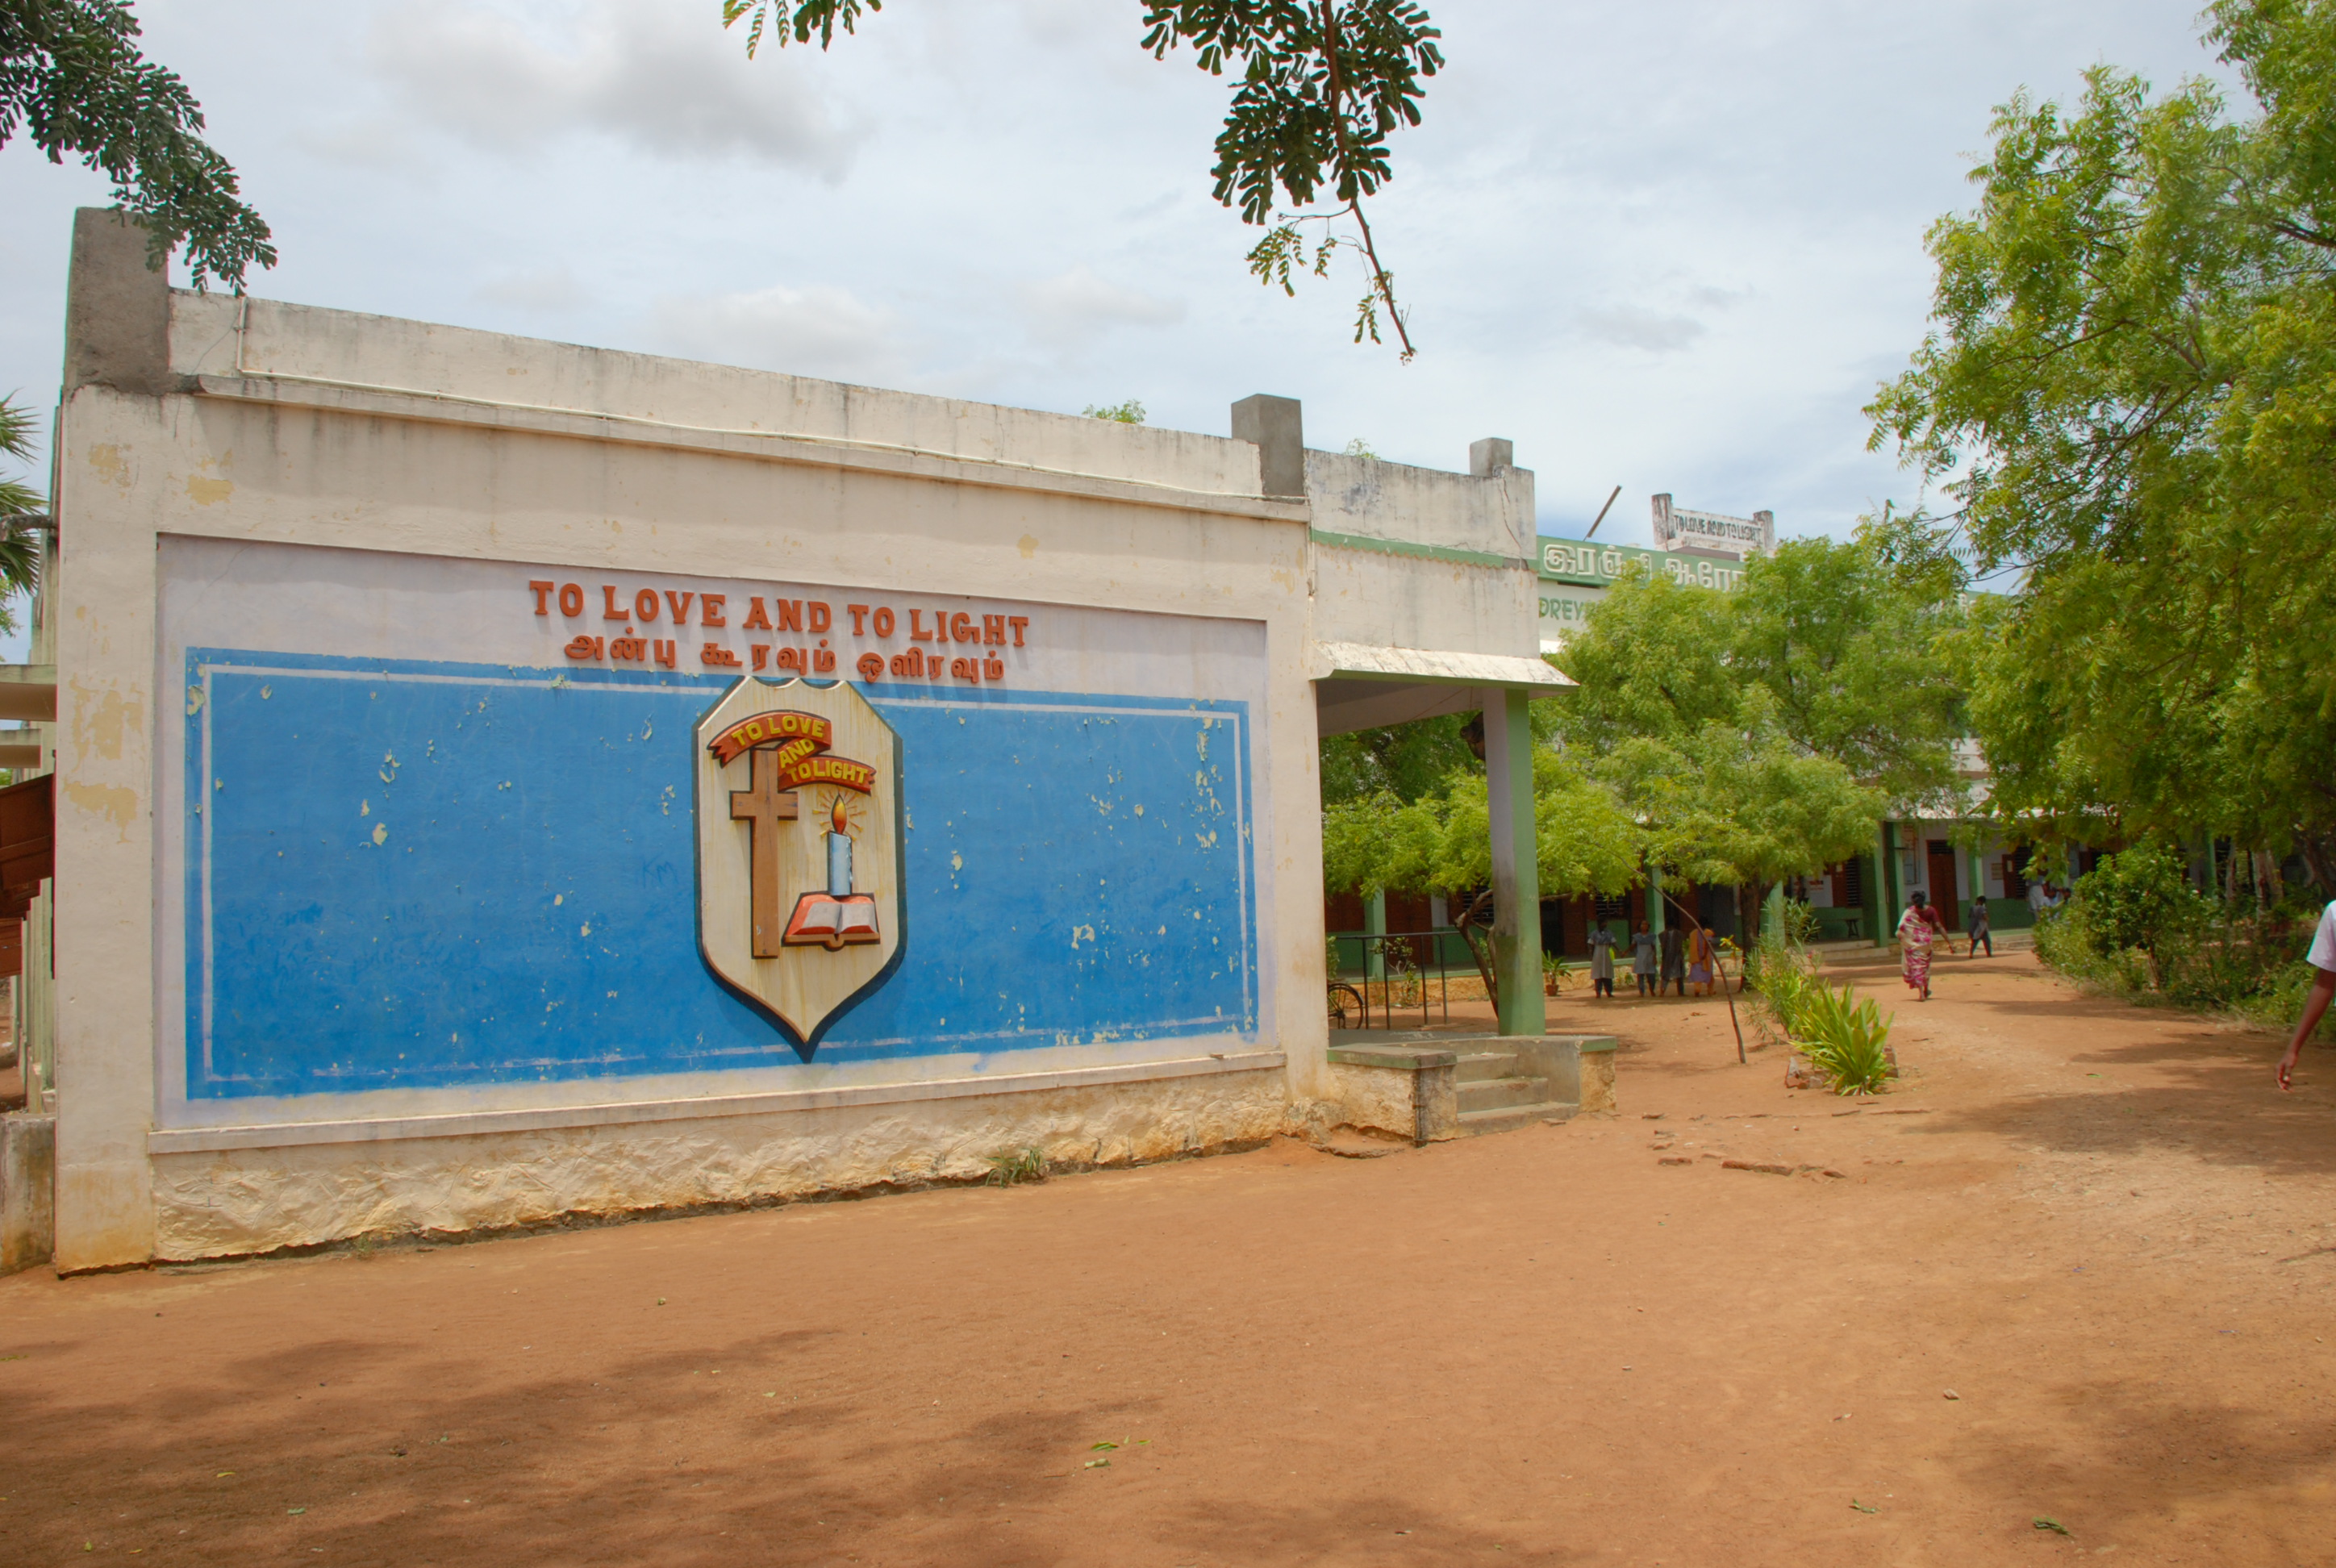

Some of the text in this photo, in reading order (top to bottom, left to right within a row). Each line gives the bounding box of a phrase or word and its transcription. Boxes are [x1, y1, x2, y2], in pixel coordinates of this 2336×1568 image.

[1674, 515, 1762, 544] TO LOVE AND TO LIGHT
[531, 581, 1028, 647] TO LOVE AND TO LIGHT
[565, 626, 1005, 684] அன்பு கூரவும் ஒளிரவும்
[731, 715, 826, 747] TO LOVE
[779, 738, 816, 769] AND
[786, 760, 869, 785] TO LIGHT
